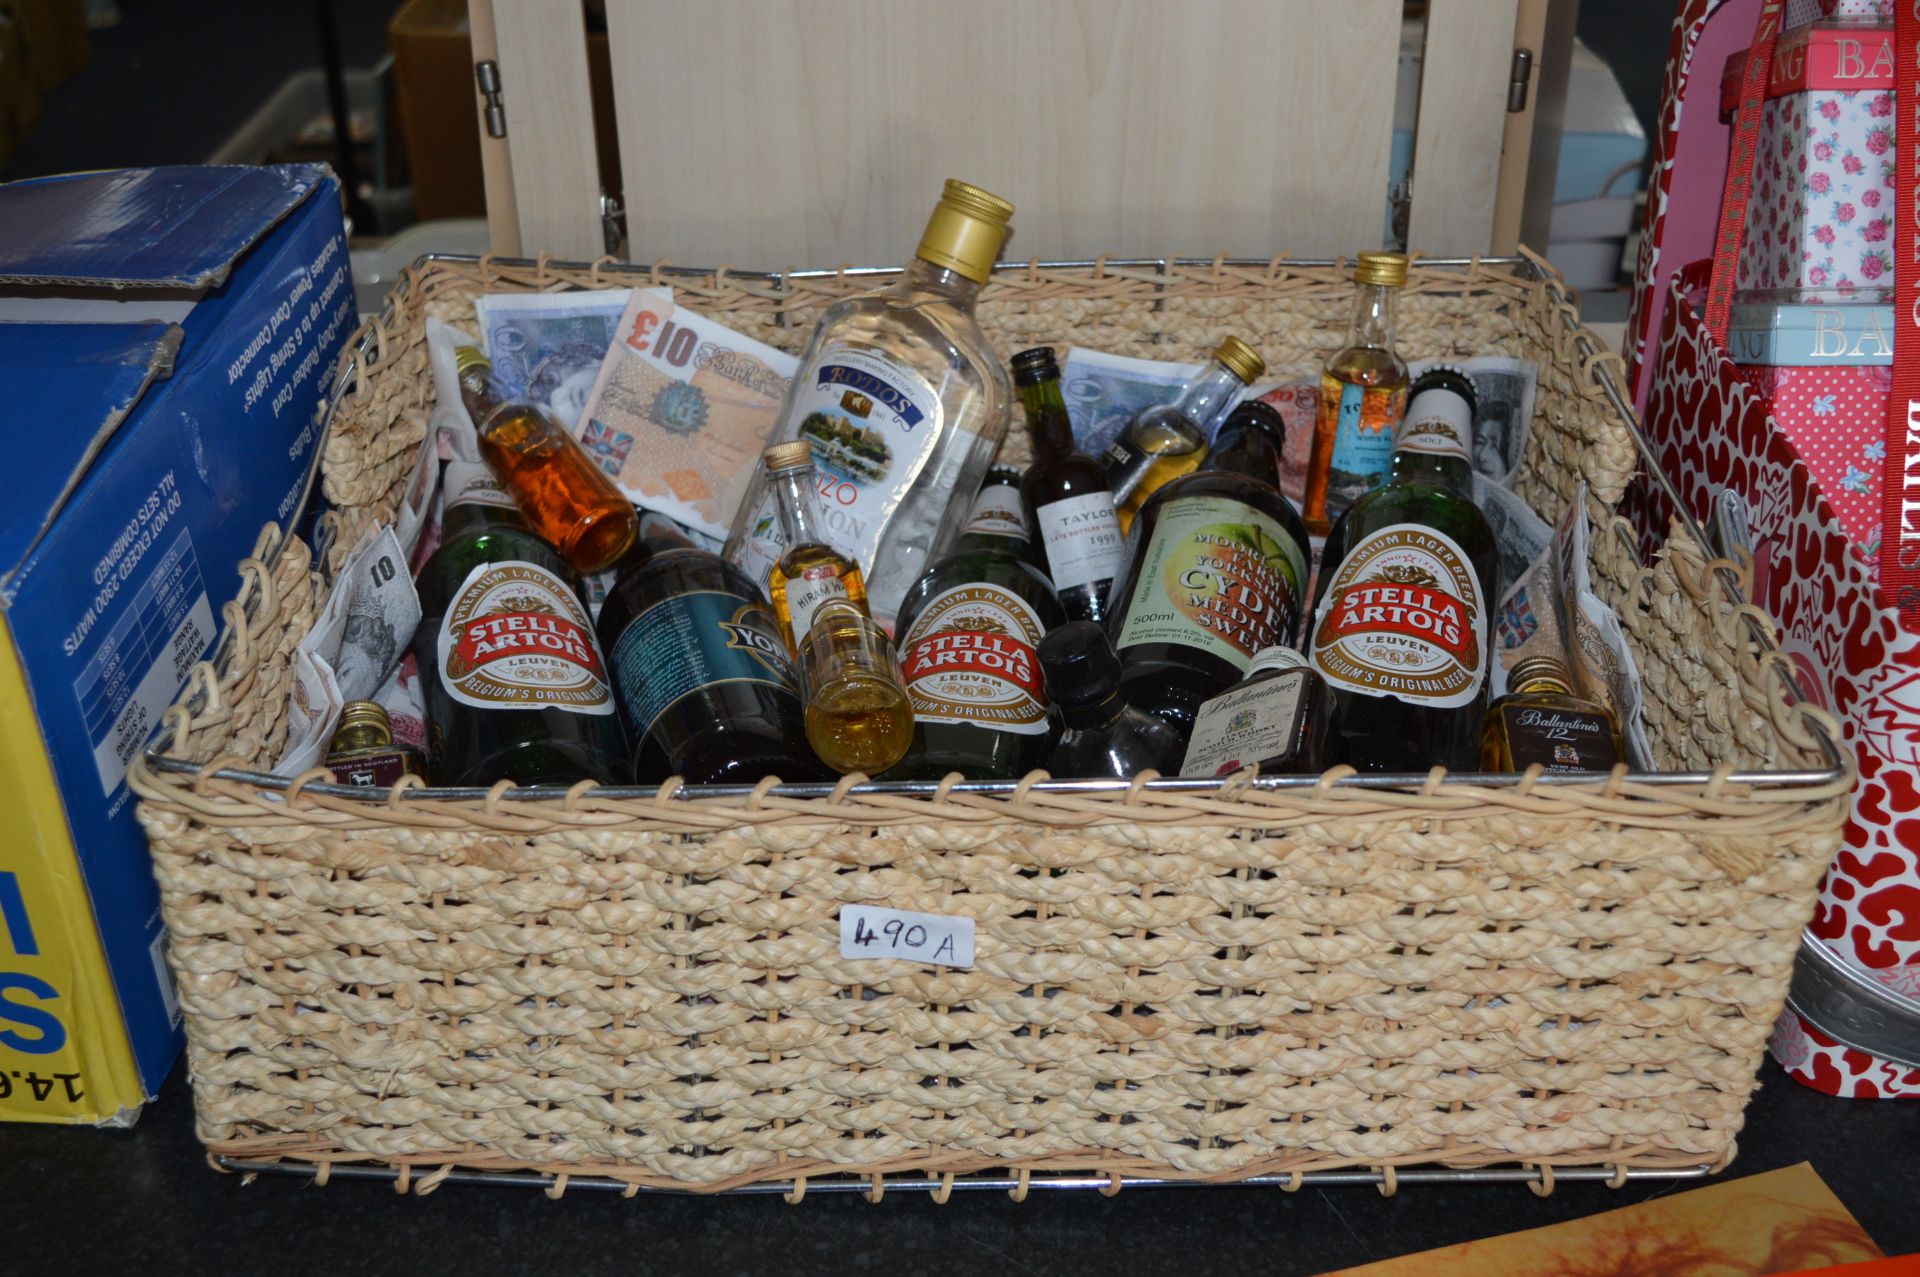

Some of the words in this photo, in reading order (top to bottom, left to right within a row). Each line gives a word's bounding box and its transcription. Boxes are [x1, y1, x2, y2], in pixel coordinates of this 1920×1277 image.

[1833, 38, 1895, 79] BA
[309, 235, 338, 282] Includes
[287, 269, 313, 312] Power
[318, 264, 345, 314] Connect
[269, 298, 291, 336] Cord
[300, 312, 312, 337] to
[308, 296, 321, 324] up
[294, 325, 303, 346] 6
[626, 310, 699, 367] £10
[1809, 309, 1894, 357] BA
[224, 323, 273, 389] Connector
[268, 332, 297, 377] String
[290, 344, 320, 394] Rubber
[316, 356, 338, 396] Spare
[829, 366, 912, 414] RODOS
[863, 361, 889, 377] MAKING
[887, 373, 915, 398] FACTORY
[270, 380, 294, 419] Cord
[287, 422, 312, 466] Bulbs
[159, 466, 174, 499] ALL
[167, 486, 180, 518] DO
[138, 485, 159, 528] SETS
[151, 503, 167, 540] NOT
[1060, 508, 1113, 526] TAYLOR
[93, 512, 139, 589] COMBINED
[118, 526, 151, 585] EXCEED
[1339, 534, 1399, 584] PREMIUM
[1407, 533, 1453, 562] LAGER
[1453, 565, 1474, 600] BEER
[370, 555, 396, 588] 10
[94, 569, 120, 617] 2300
[456, 569, 506, 619] PREMIUM
[512, 569, 561, 594] LAGER
[796, 584, 831, 608] HIRAM
[975, 590, 1022, 613] LAGER
[1343, 588, 1461, 627] STELLA
[62, 602, 96, 662] WATTS
[173, 615, 193, 653] RANGE
[469, 616, 584, 647] STELLA
[1133, 612, 1175, 625] 500ml
[1155, 626, 1183, 635] content
[1188, 592, 1276, 646] MEDIU
[1338, 606, 1461, 646] ARTOIS
[173, 623, 199, 671] WATTAGE
[176, 632, 204, 685] MAXIMUM
[473, 632, 591, 663] ARTOIS
[508, 657, 570, 670] LEUVEN
[916, 635, 1031, 667] STELLA
[1366, 636, 1430, 653] LEUVEN
[912, 651, 1031, 683] ARTOIS
[939, 675, 1002, 688] LEUVEN
[1322, 648, 1375, 683] BELGIUM'S
[1379, 675, 1447, 691] ORIGINAL
[1445, 668, 1467, 690] BEER
[464, 677, 530, 699] BELGIUM'S
[536, 689, 594, 702] ORIGINAL
[116, 698, 137, 737] LIGHTS
[137, 704, 146, 725] OF
[955, 706, 1020, 720] ORIGINAL
[1515, 709, 1600, 732] Ballantine's
[115, 717, 138, 758] STRING
[121, 719, 147, 766] NUMBER
[1544, 727, 1578, 742] 12
[327, 763, 353, 771] OTTLED
[363, 758, 398, 767] SCOTLAND
[854, 916, 927, 948] 490
[933, 933, 954, 961] A
